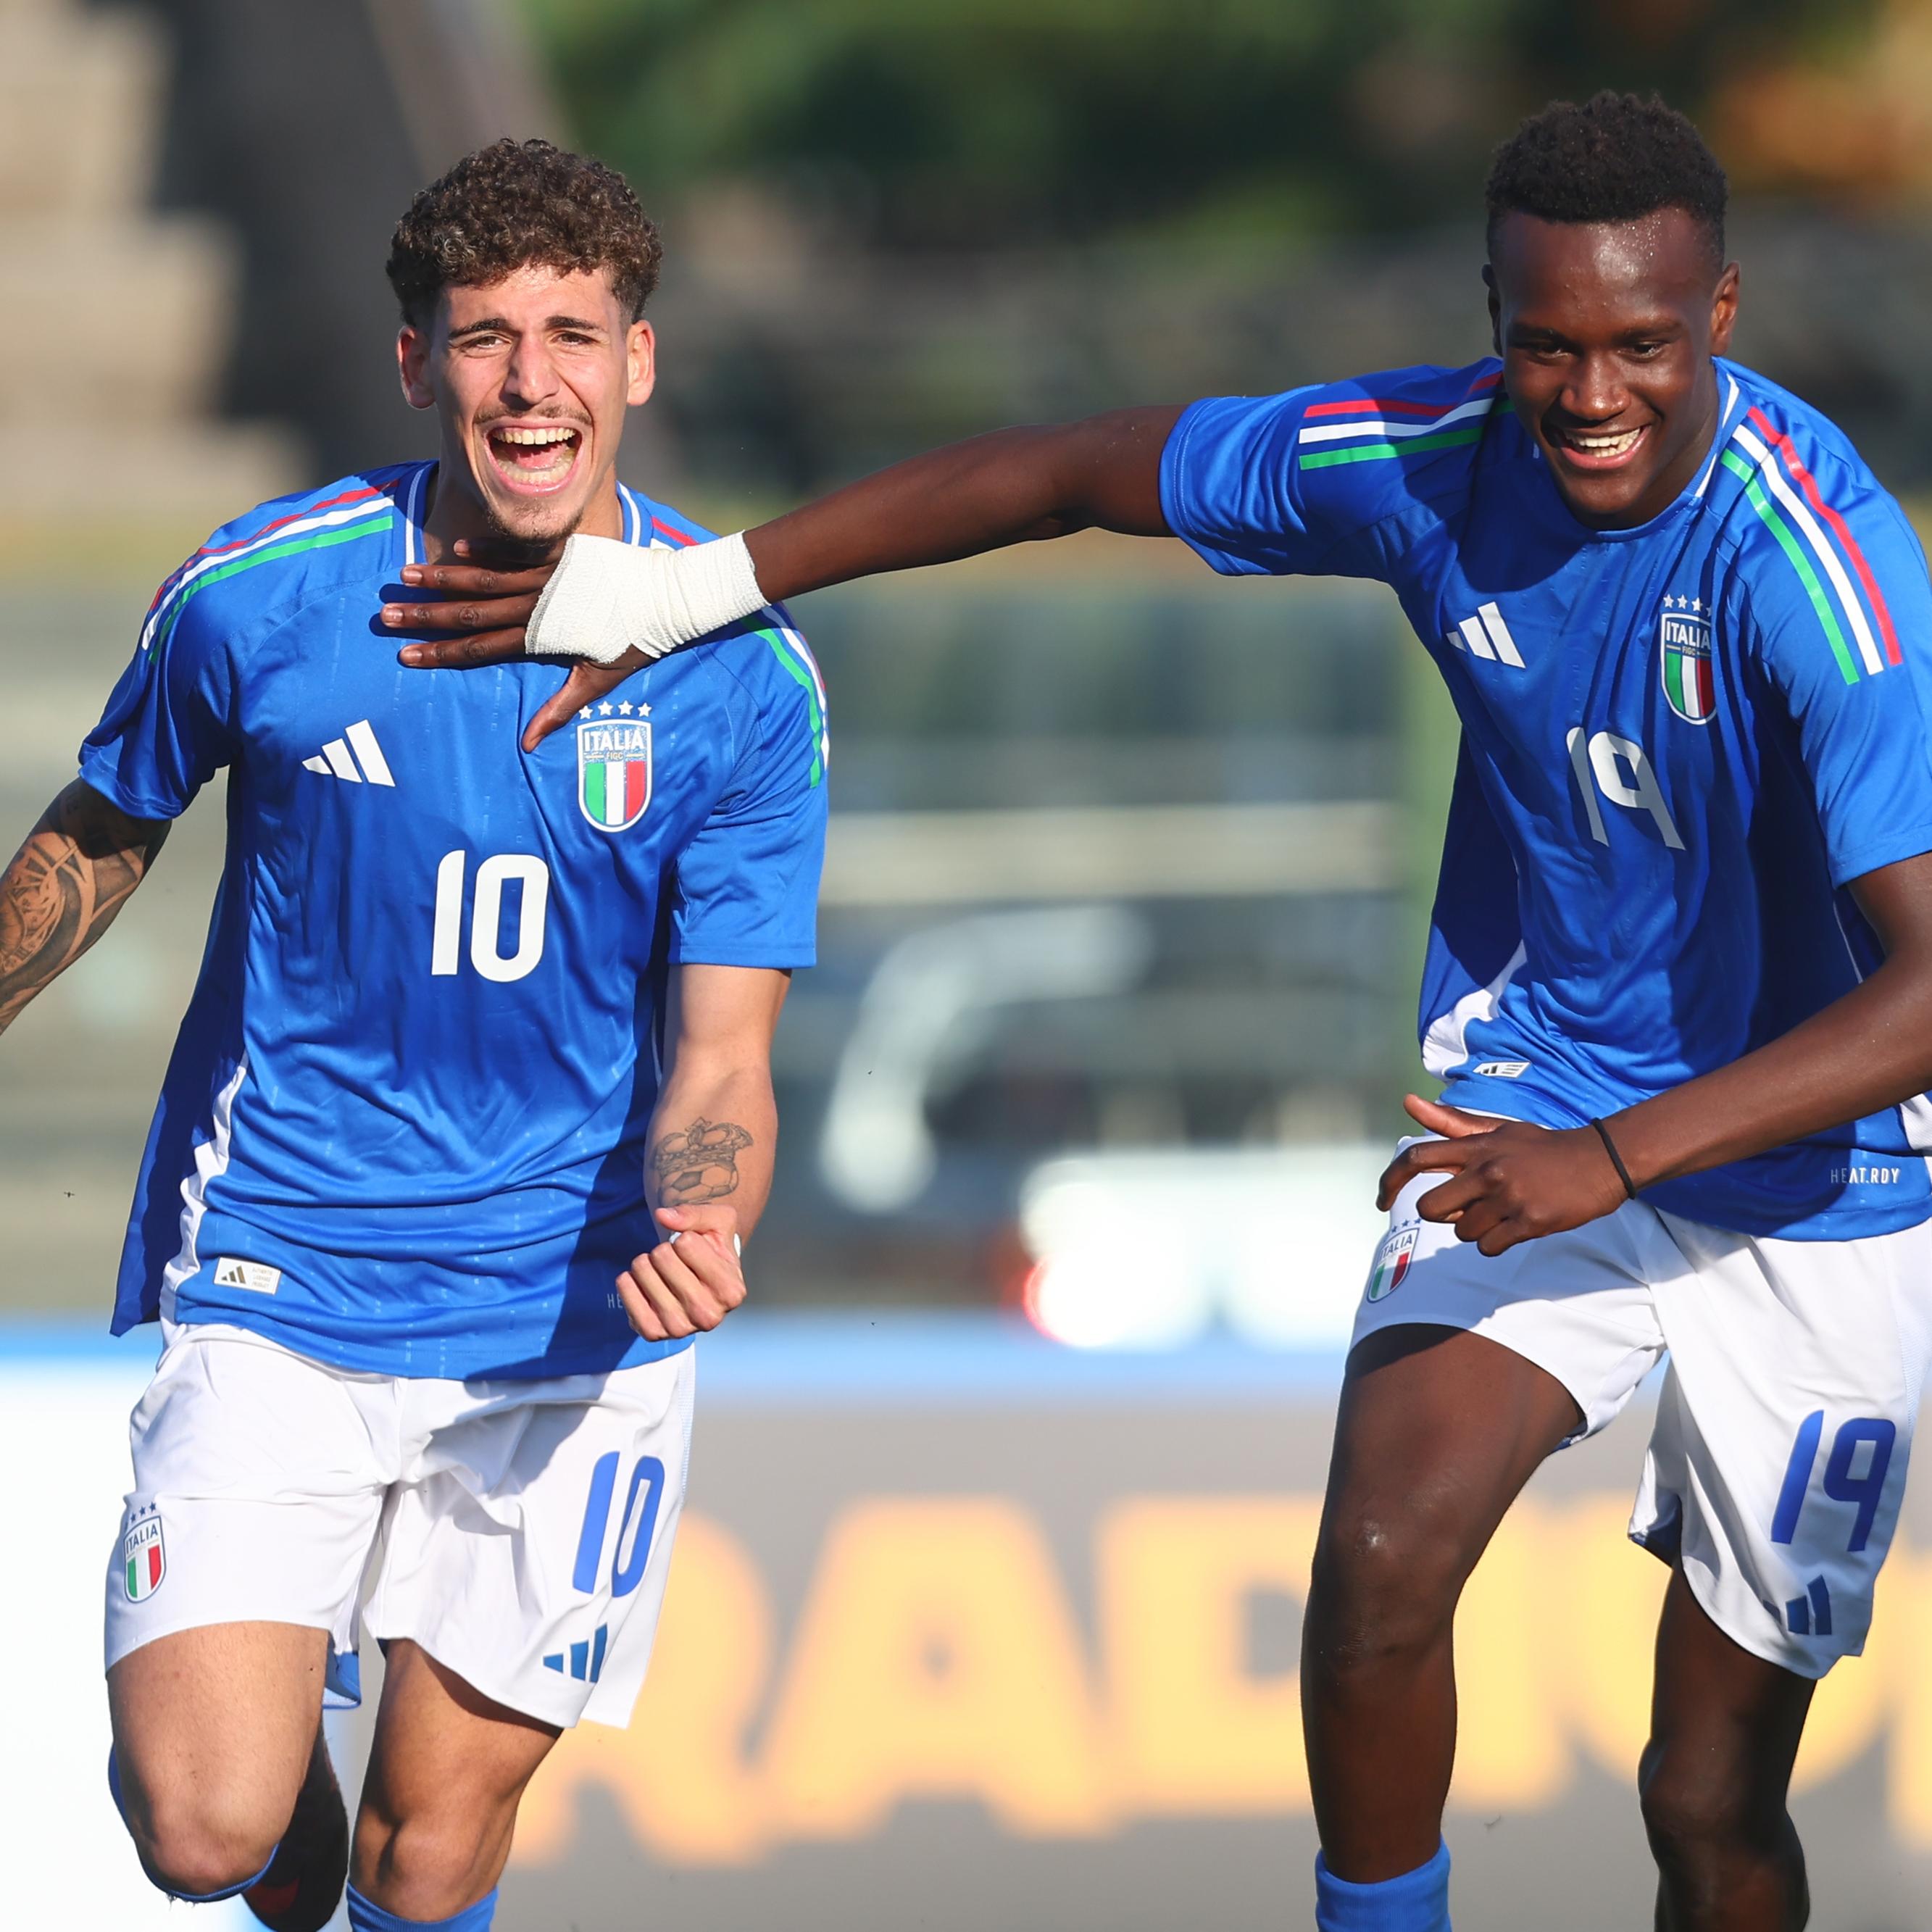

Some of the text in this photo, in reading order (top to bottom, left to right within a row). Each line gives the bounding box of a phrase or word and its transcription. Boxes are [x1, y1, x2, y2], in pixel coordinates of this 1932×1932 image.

[1667, 621, 1710, 649] ITALIA
[584, 729, 644, 751] ITALIA
[1566, 727, 1686, 850] 19
[432, 850, 549, 982] 10
[1830, 1167, 1900, 1183] HEAT.RDY
[1380, 1234, 1412, 1259] ITALIA
[1770, 1410, 1896, 1552] 19
[126, 1523, 158, 1554] ITALIA
[572, 1451, 665, 1597] 10
